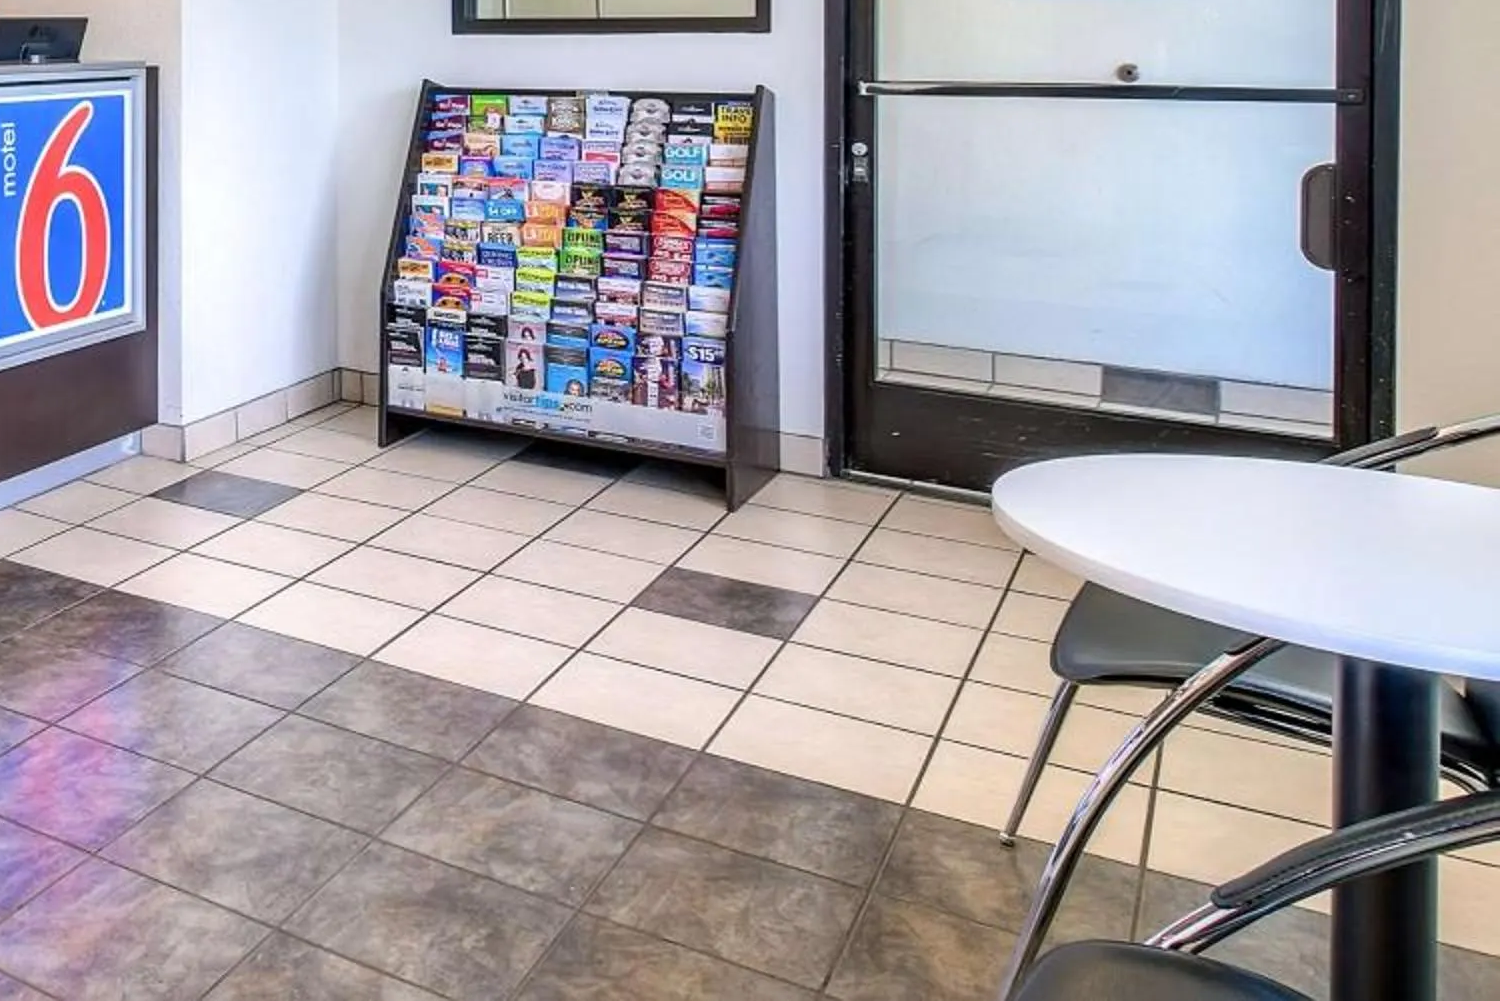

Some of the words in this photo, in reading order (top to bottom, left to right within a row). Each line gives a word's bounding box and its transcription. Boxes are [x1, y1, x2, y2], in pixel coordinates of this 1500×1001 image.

[1, 122, 17, 197] motel
[665, 146, 699, 159] GOLF
[15, 100, 111, 331] 6
